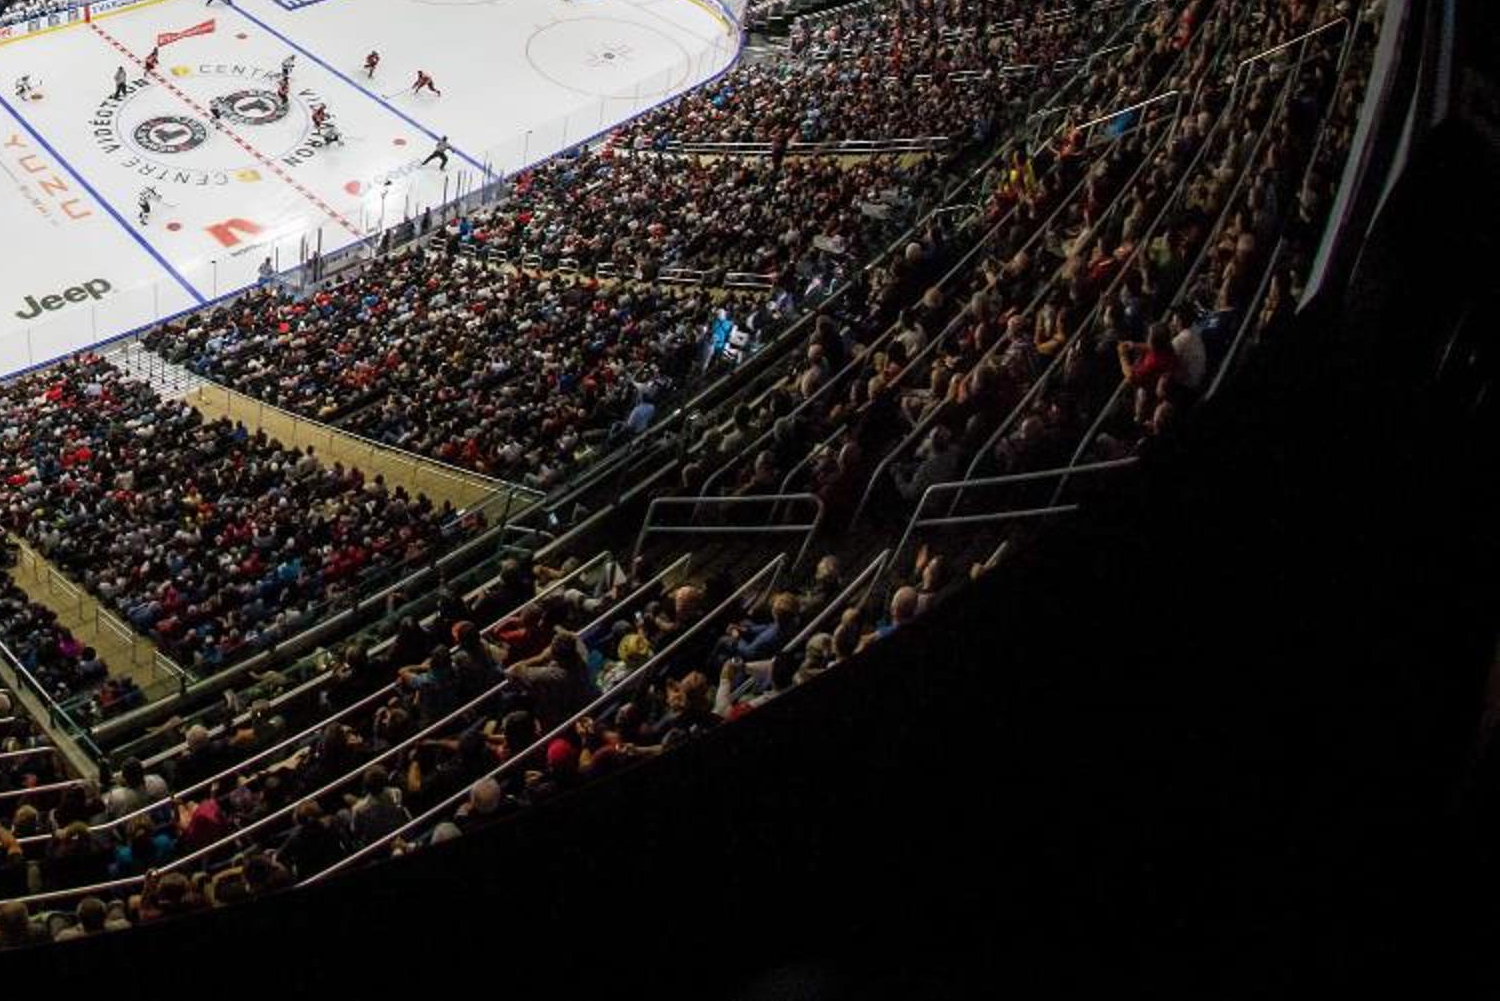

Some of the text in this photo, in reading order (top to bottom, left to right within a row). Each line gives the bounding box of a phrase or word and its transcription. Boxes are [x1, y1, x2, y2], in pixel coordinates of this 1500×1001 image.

[88, 78, 150, 154] VIDÉOTON
[4, 134, 92, 220] YUZU
[15, 278, 112, 320] Jeep
